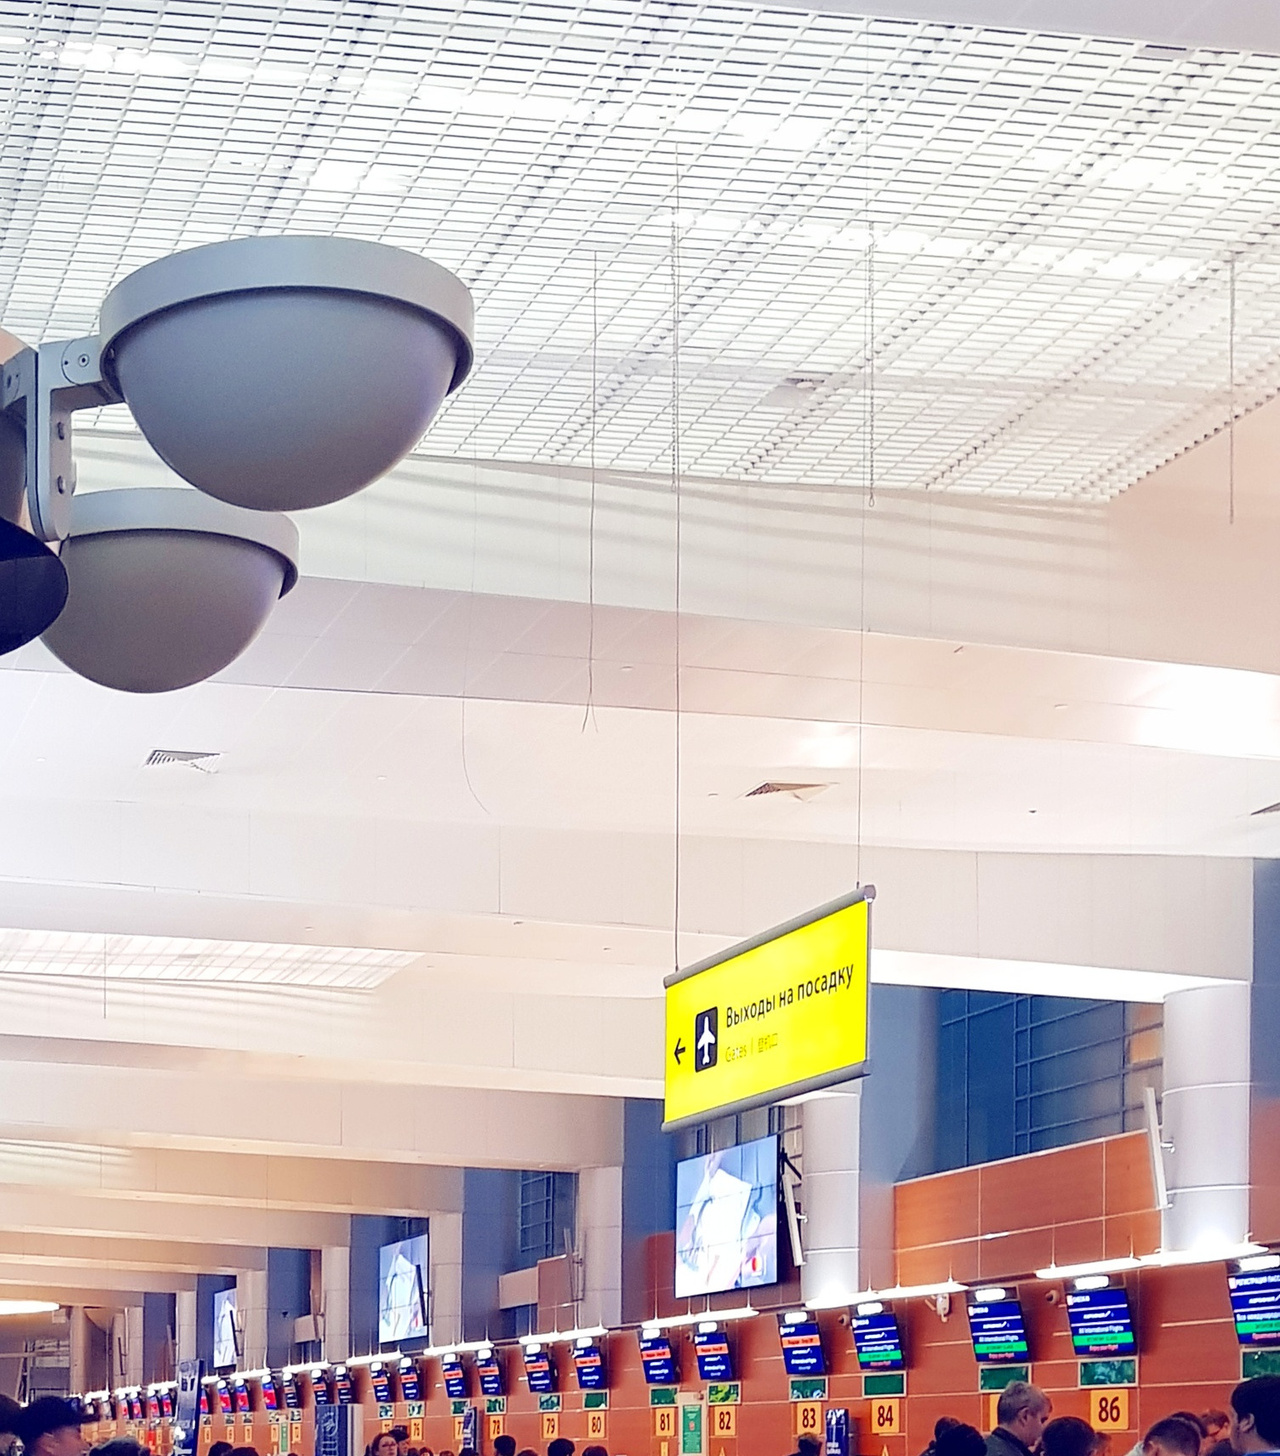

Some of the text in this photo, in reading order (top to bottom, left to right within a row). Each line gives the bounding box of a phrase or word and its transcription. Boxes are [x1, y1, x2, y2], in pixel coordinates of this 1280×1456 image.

[726, 963, 854, 1028] Выходы на посадку
[725, 1044, 748, 1063] Gates
[802, 1407, 817, 1429] 83
[877, 1405, 894, 1427] 84
[1098, 1396, 1121, 1423] 86
[546, 1418, 556, 1434] 79
[591, 1416, 602, 1434] 80
[659, 1413, 670, 1431] 81
[719, 1411, 732, 1431] 82
